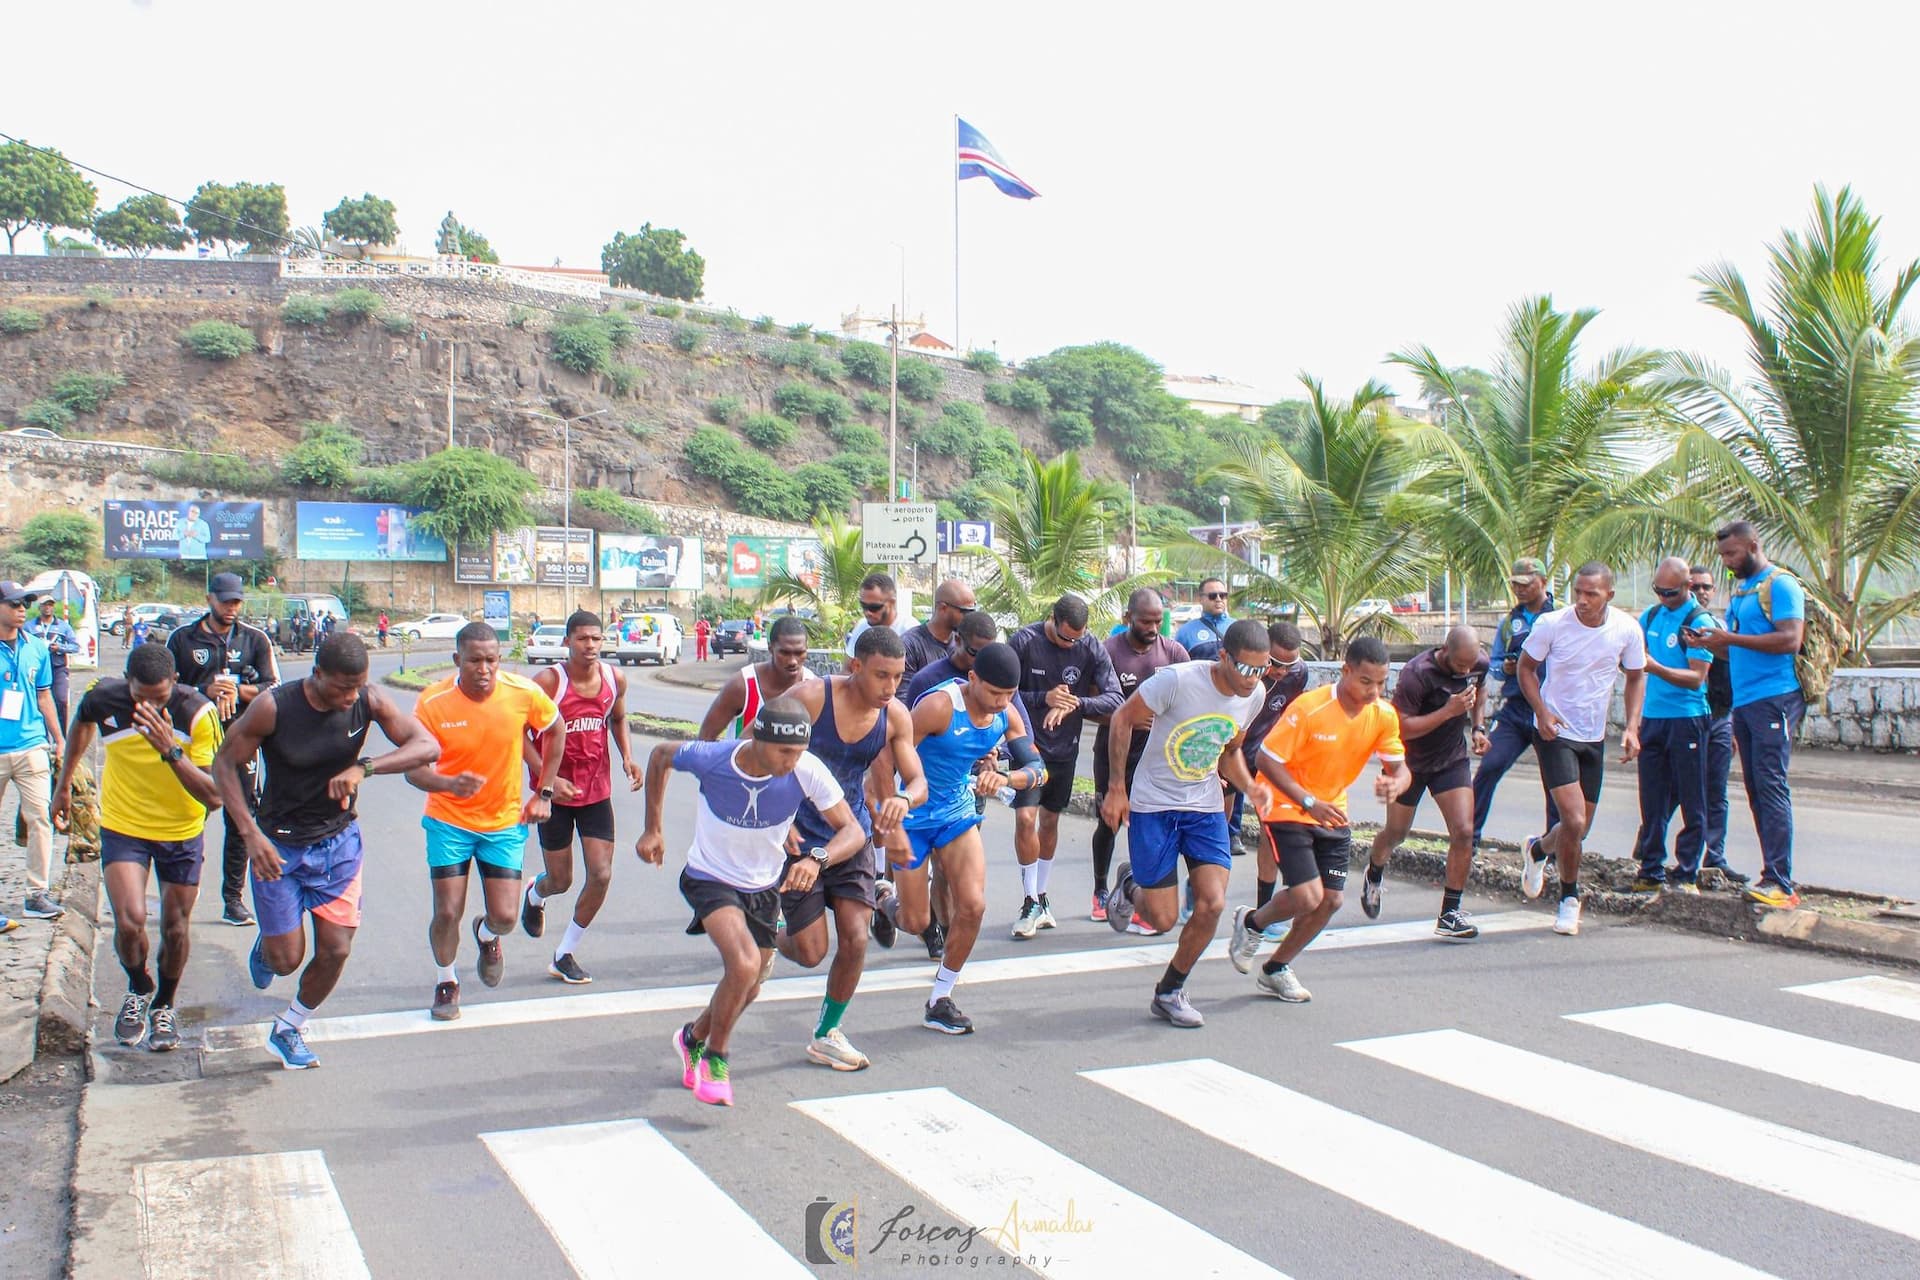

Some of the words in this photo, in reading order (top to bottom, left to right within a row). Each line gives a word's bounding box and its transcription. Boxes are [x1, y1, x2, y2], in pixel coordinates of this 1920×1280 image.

[894, 506, 933, 514] aeroporto
[123, 509, 179, 528] GRACE
[902, 515, 925, 523] porto
[865, 541, 896, 549] Plateau
[1328, 869, 1347, 877] KELM
